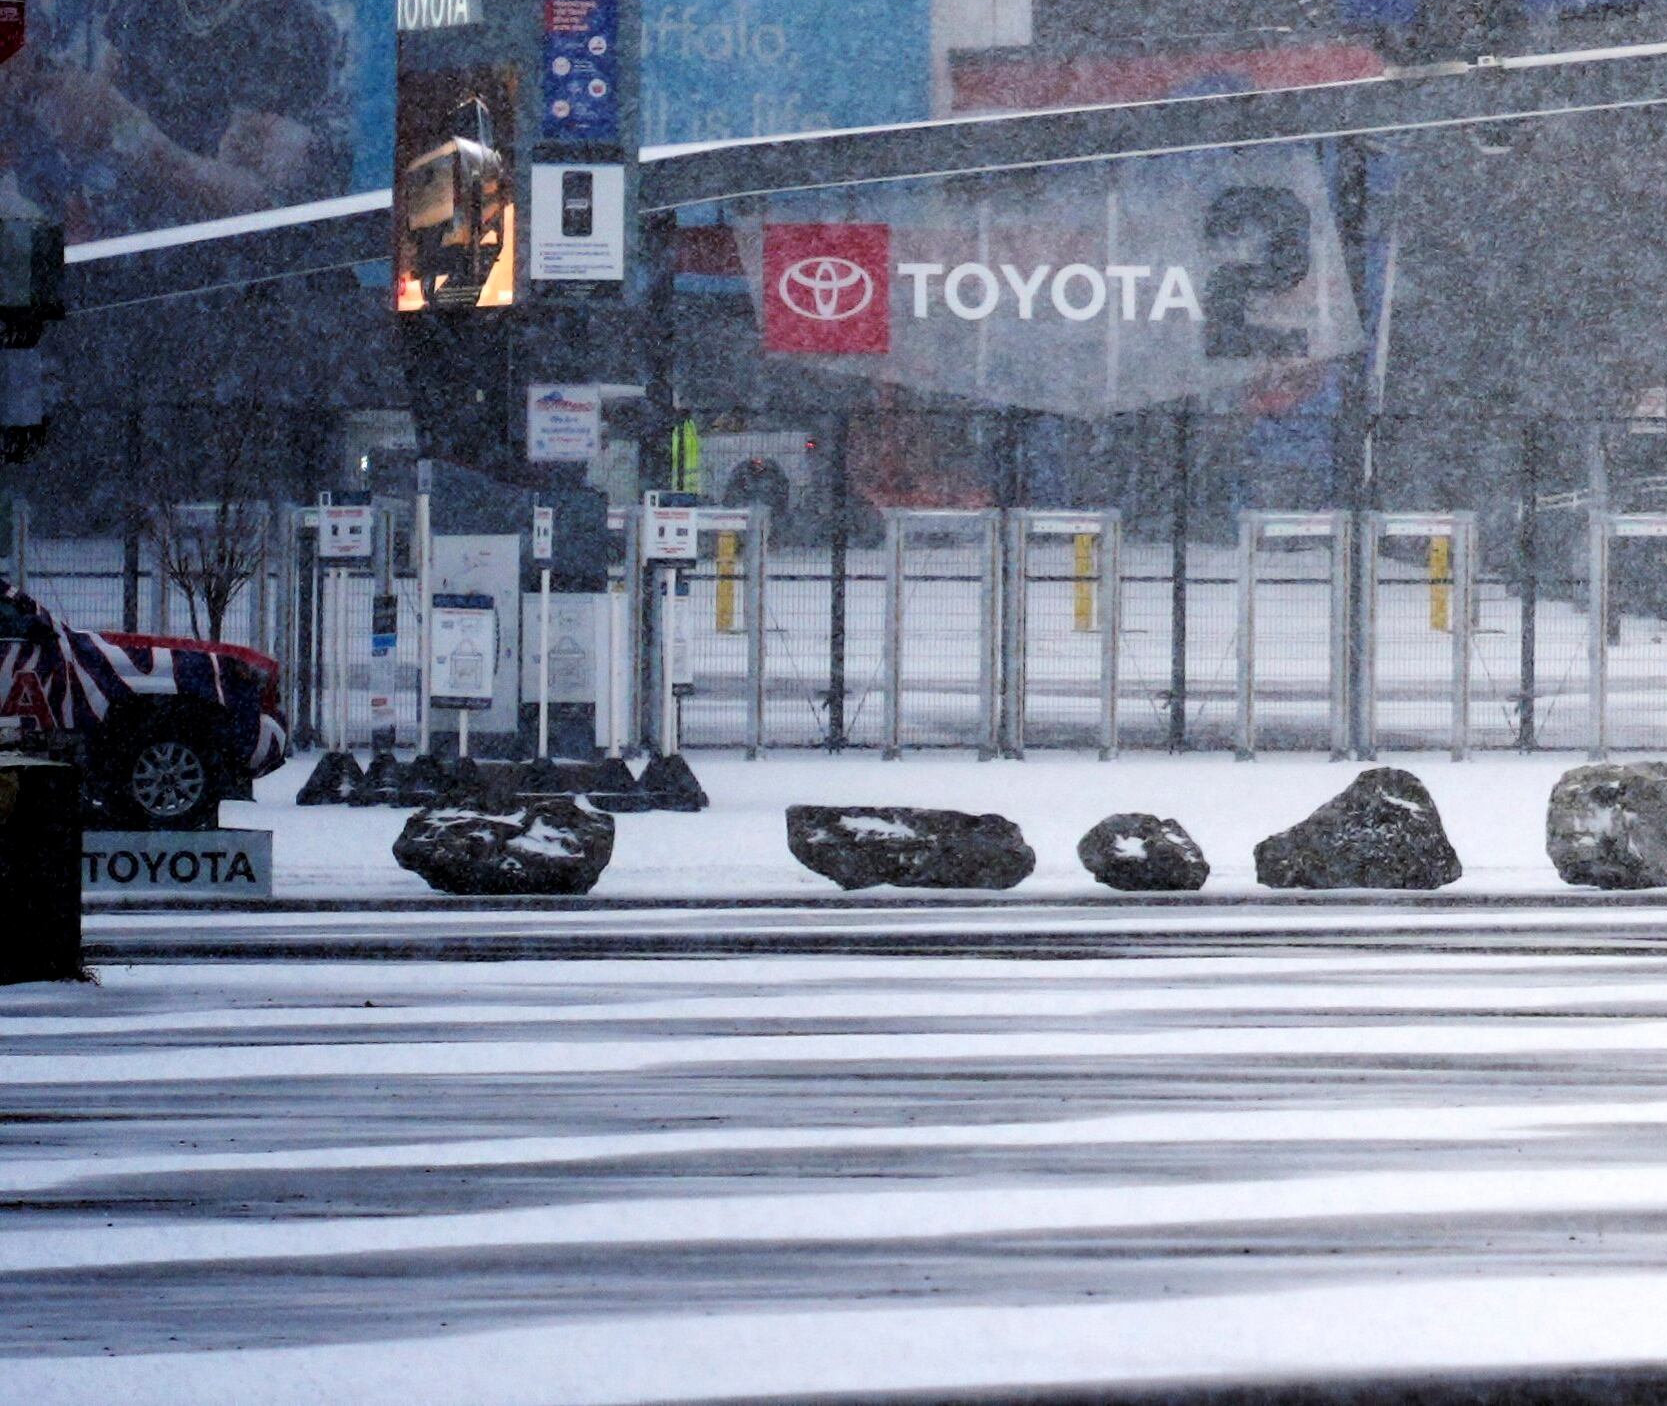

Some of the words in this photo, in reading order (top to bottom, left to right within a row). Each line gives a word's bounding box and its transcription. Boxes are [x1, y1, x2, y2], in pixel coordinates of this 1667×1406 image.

[898, 262, 1204, 322] TOYOTA
[1202, 185, 1311, 357] 2
[82, 850, 257, 884] TOYOTA
